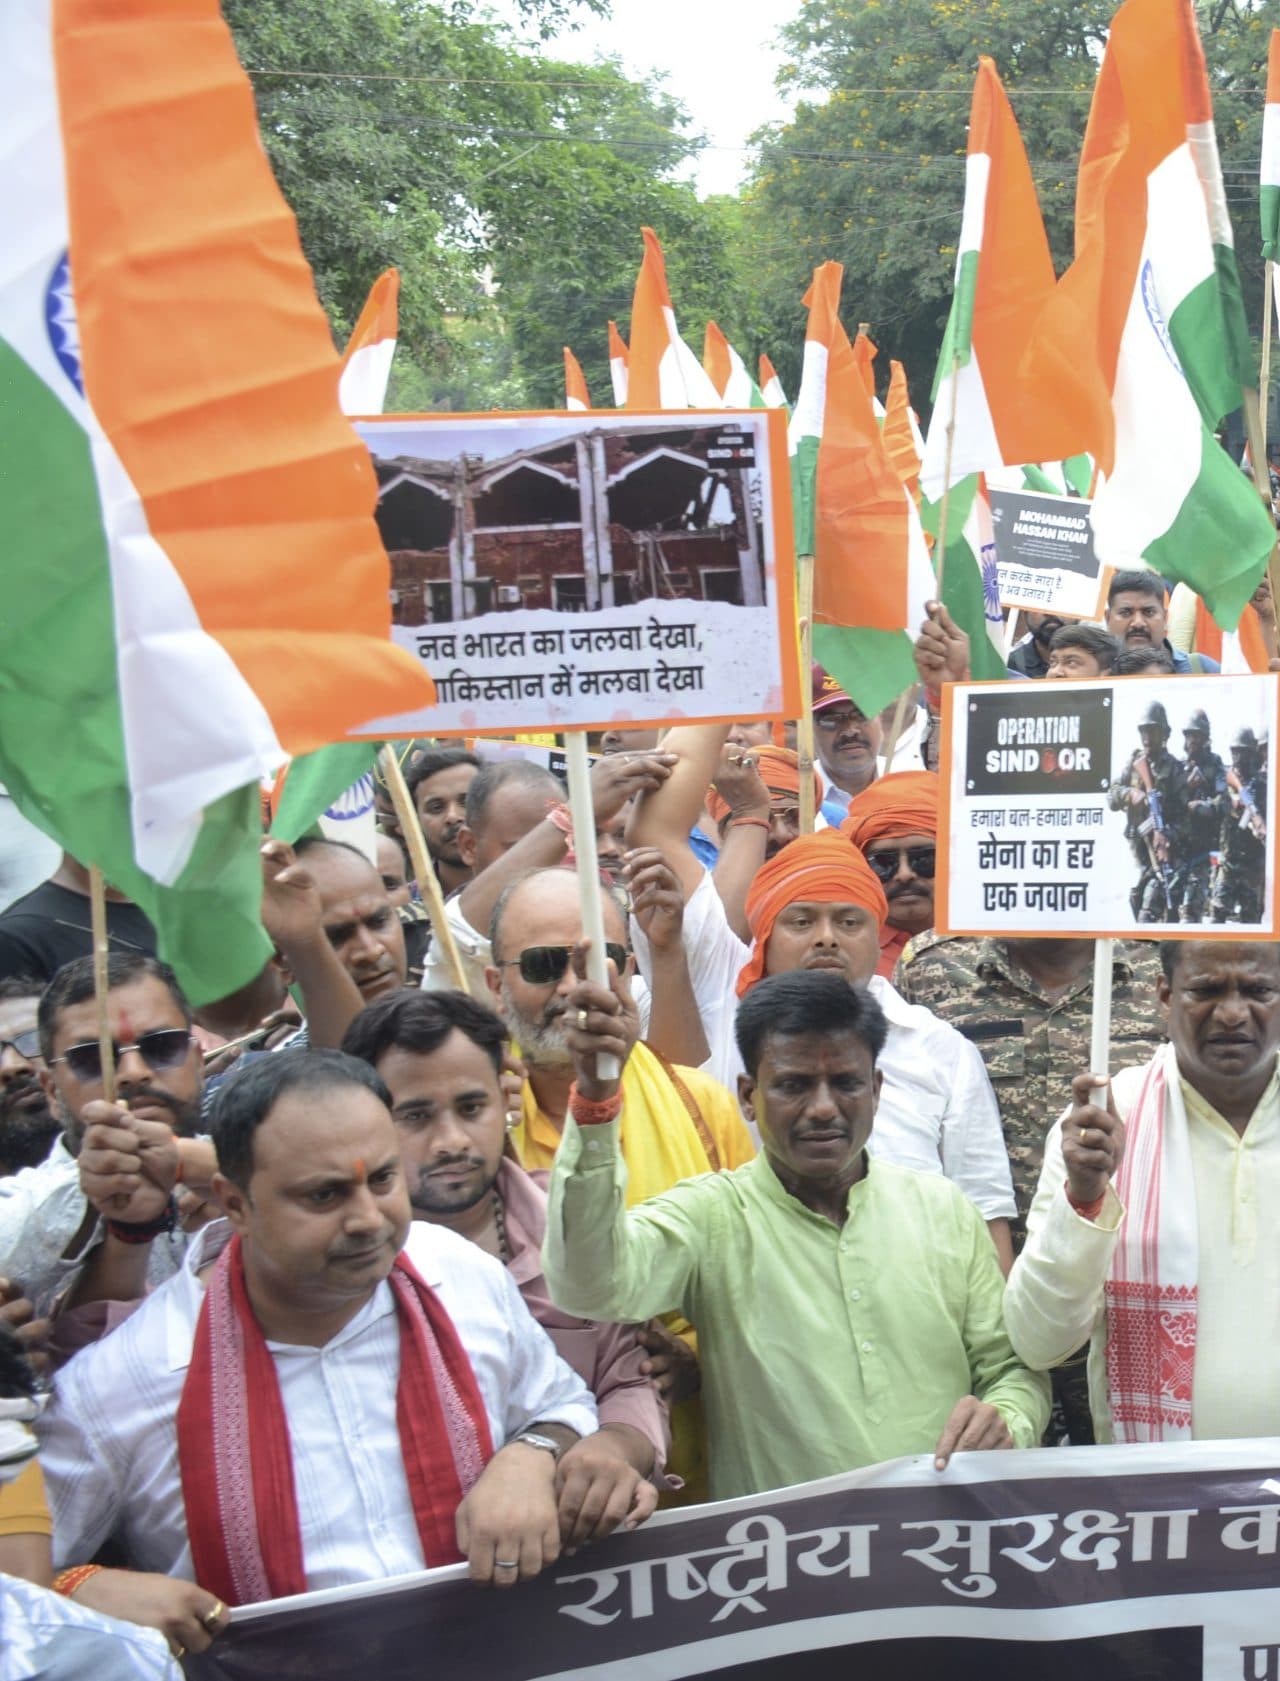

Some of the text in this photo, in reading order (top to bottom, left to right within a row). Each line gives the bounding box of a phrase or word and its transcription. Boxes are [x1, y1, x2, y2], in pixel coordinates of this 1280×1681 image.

[1012, 522, 1089, 544] HASSAN KHAN
[1019, 510, 1087, 530] MOHAMMAD
[416, 615, 703, 661] नव भारत का जलवा देखा,
[548, 663, 575, 698] में
[576, 668, 651, 696] मलबा
[653, 658, 705, 694] देखा
[997, 715, 1081, 746] OPERATION
[970, 808, 1006, 828] हमारा
[1075, 807, 1104, 827] मान
[978, 830, 1096, 870] सेना का हर
[982, 882, 1089, 912] एक जवान
[555, 1514, 880, 1626] राष्ट्रीय
[901, 1506, 1199, 1598] सुरक्षा
